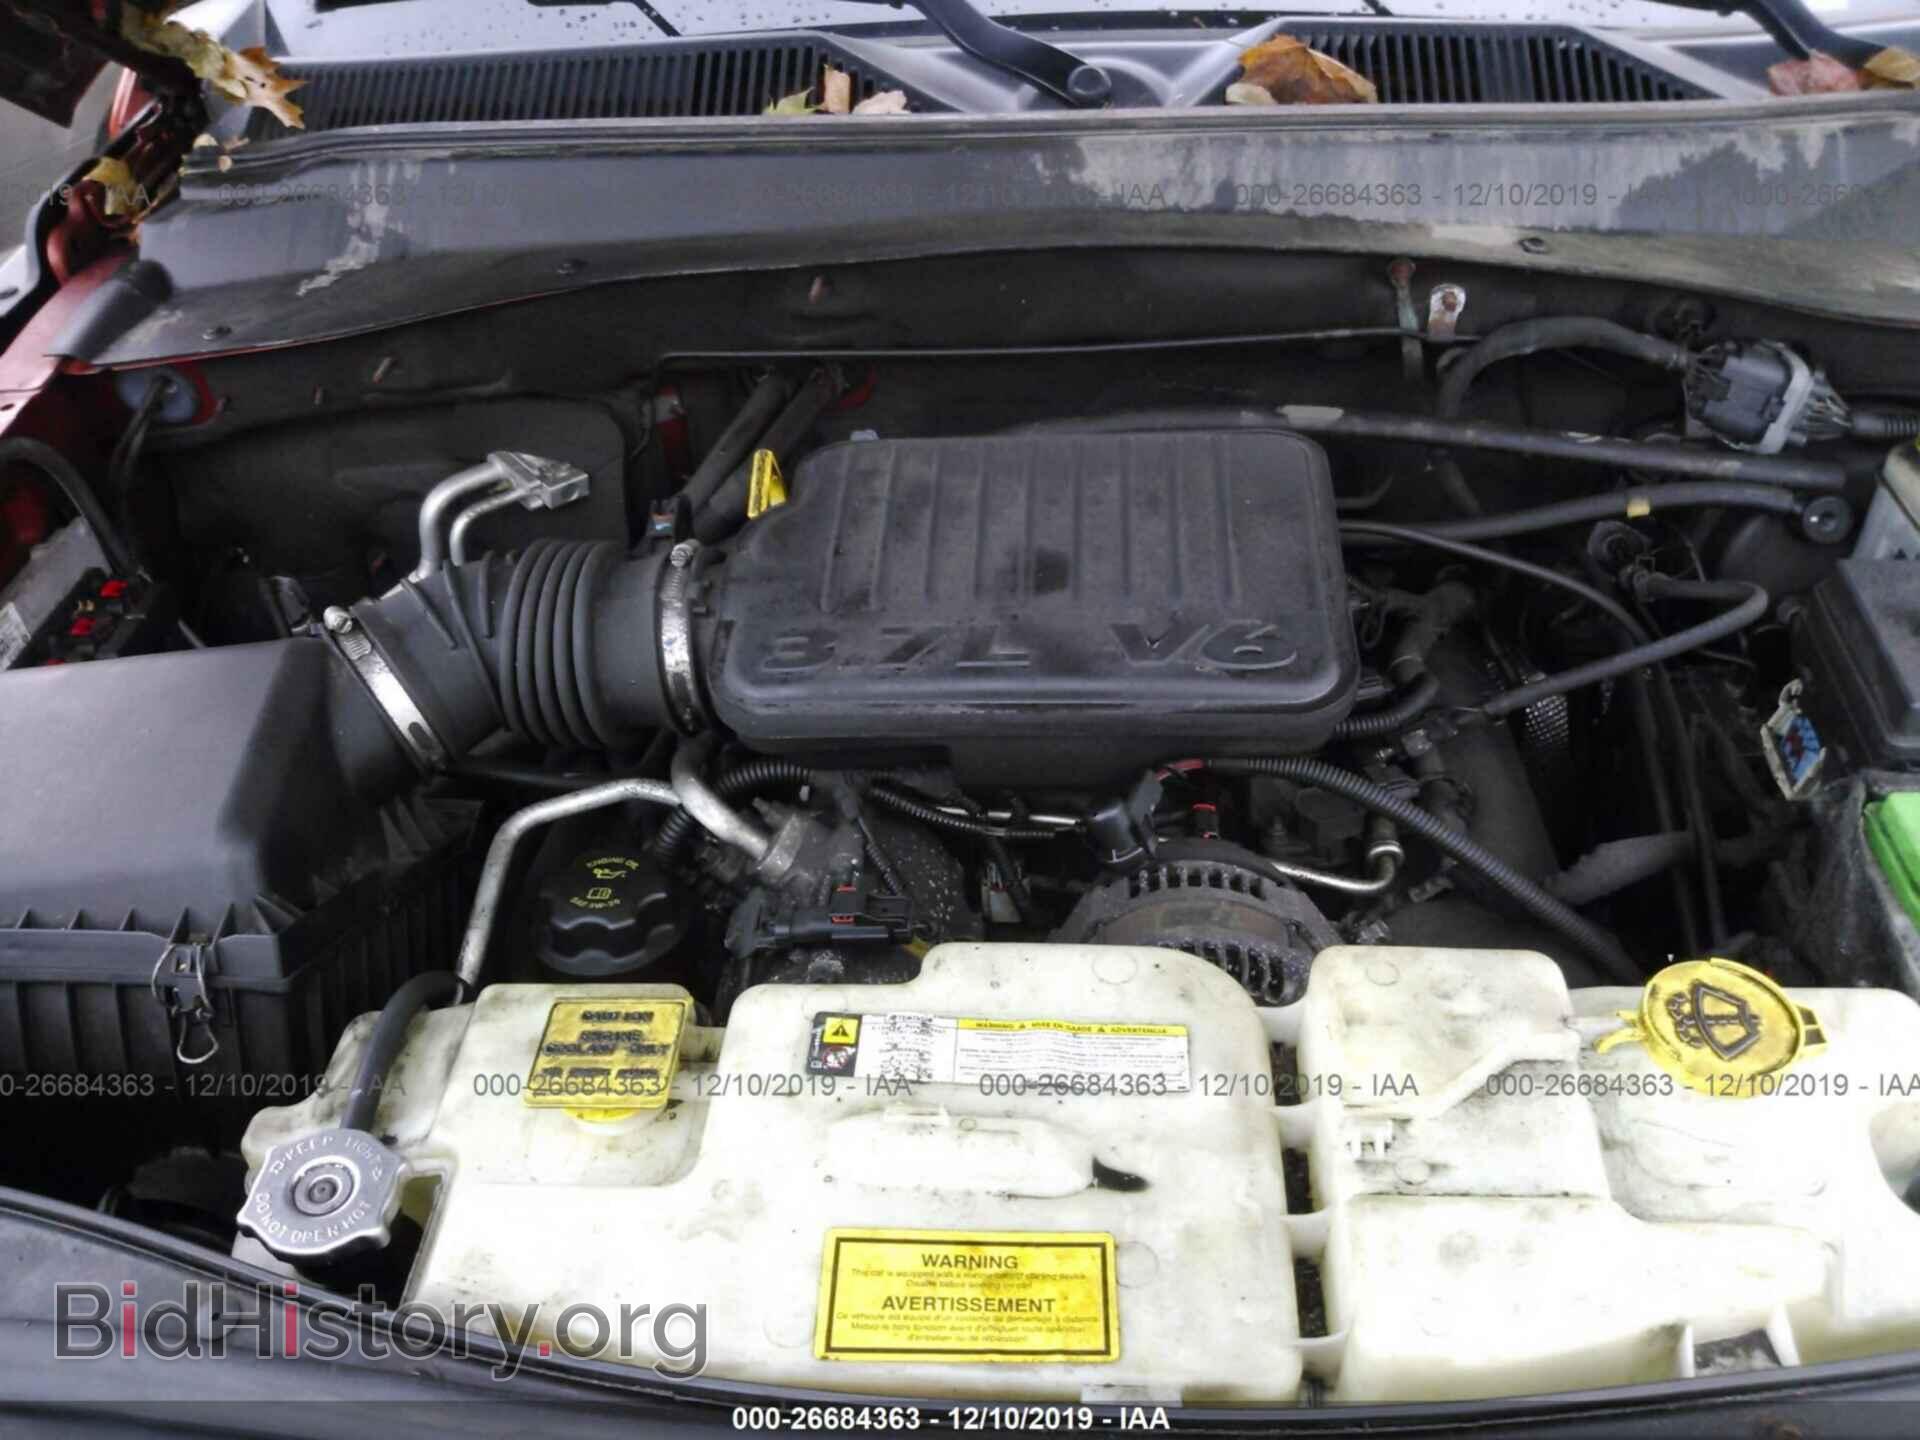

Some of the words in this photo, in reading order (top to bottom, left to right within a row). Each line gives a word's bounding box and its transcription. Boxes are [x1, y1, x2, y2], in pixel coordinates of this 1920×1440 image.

[1108, 620, 1298, 672] V6
[920, 1253, 1019, 1270] WARNING
[881, 1295, 1057, 1313] AVERTISSEMENT
